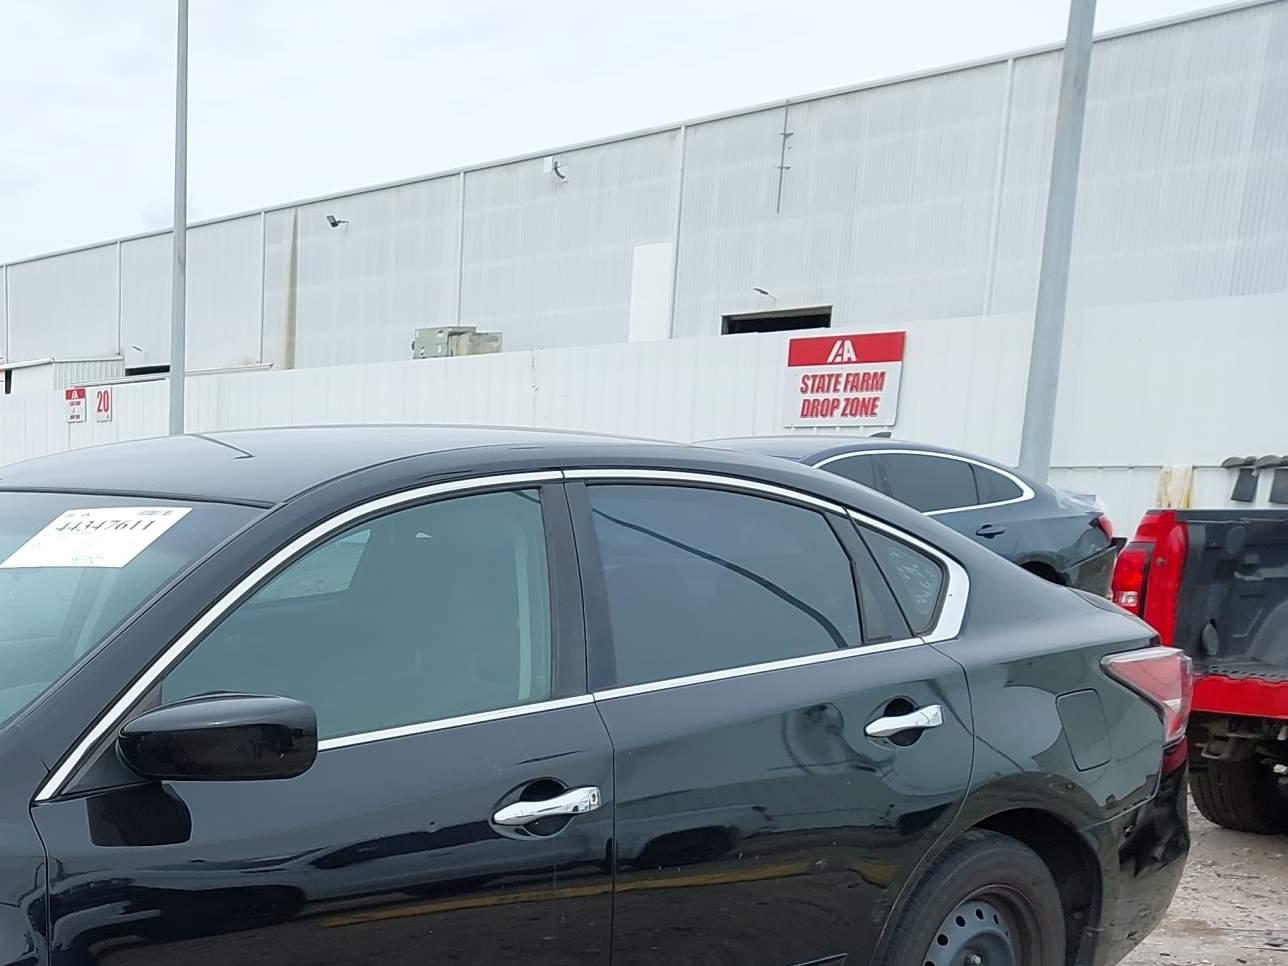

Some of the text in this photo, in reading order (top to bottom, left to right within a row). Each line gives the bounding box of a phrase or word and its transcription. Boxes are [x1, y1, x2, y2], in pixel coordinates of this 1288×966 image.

[800, 371, 885, 394] STATE FARM
[97, 390, 110, 413] 20
[800, 397, 880, 418] DROP ZONE
[55, 519, 156, 532] 44347611
